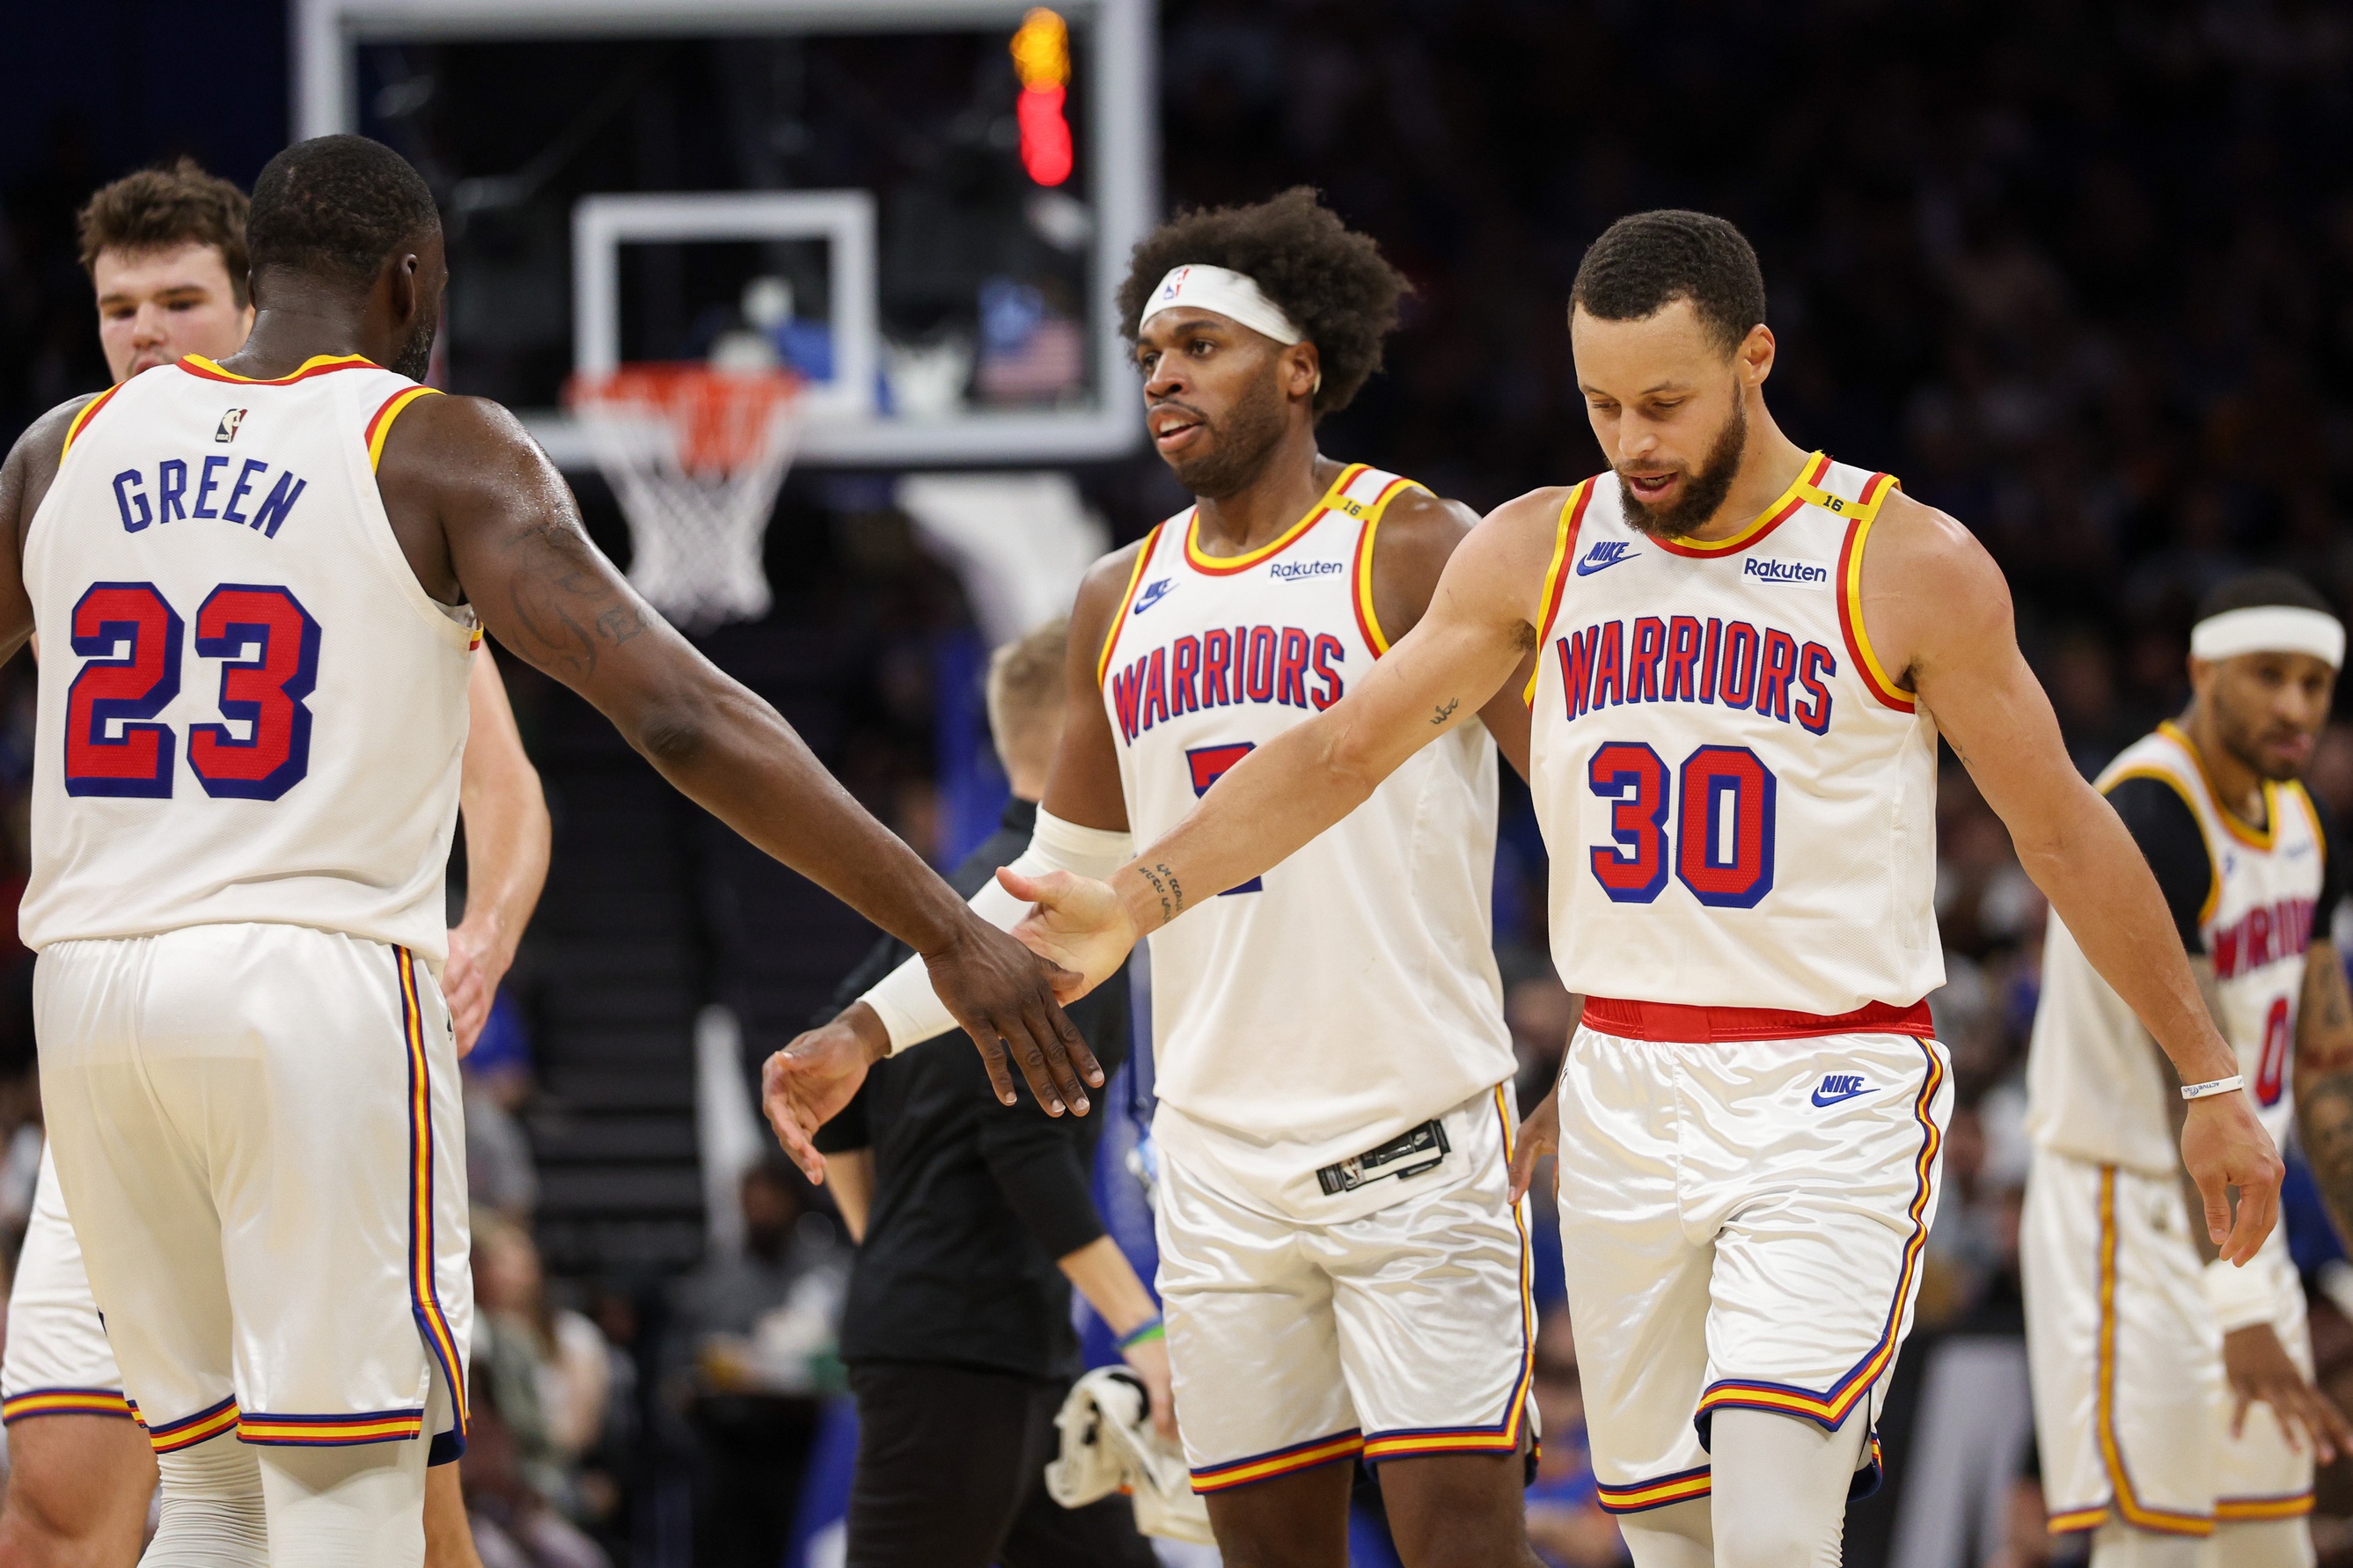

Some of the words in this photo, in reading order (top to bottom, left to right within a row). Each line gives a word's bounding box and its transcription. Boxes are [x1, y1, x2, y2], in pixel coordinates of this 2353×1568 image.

[112, 455, 307, 539] GREEN
[1343, 500, 1362, 516] 16
[1822, 495, 1844, 512] 16
[1587, 541, 1630, 561] NIKE
[1270, 560, 1344, 578] Rakuten
[1743, 557, 1828, 583] Rakuten
[1112, 625, 1345, 748] WARRIORS
[1556, 615, 1836, 737] WARRIORS
[64, 581, 322, 802] 23
[1587, 741, 1778, 909] 30
[2254, 994, 2290, 1108] 0
[1820, 1075, 1865, 1093] NIKE
[2197, 1081, 2220, 1091] ACTIVE
